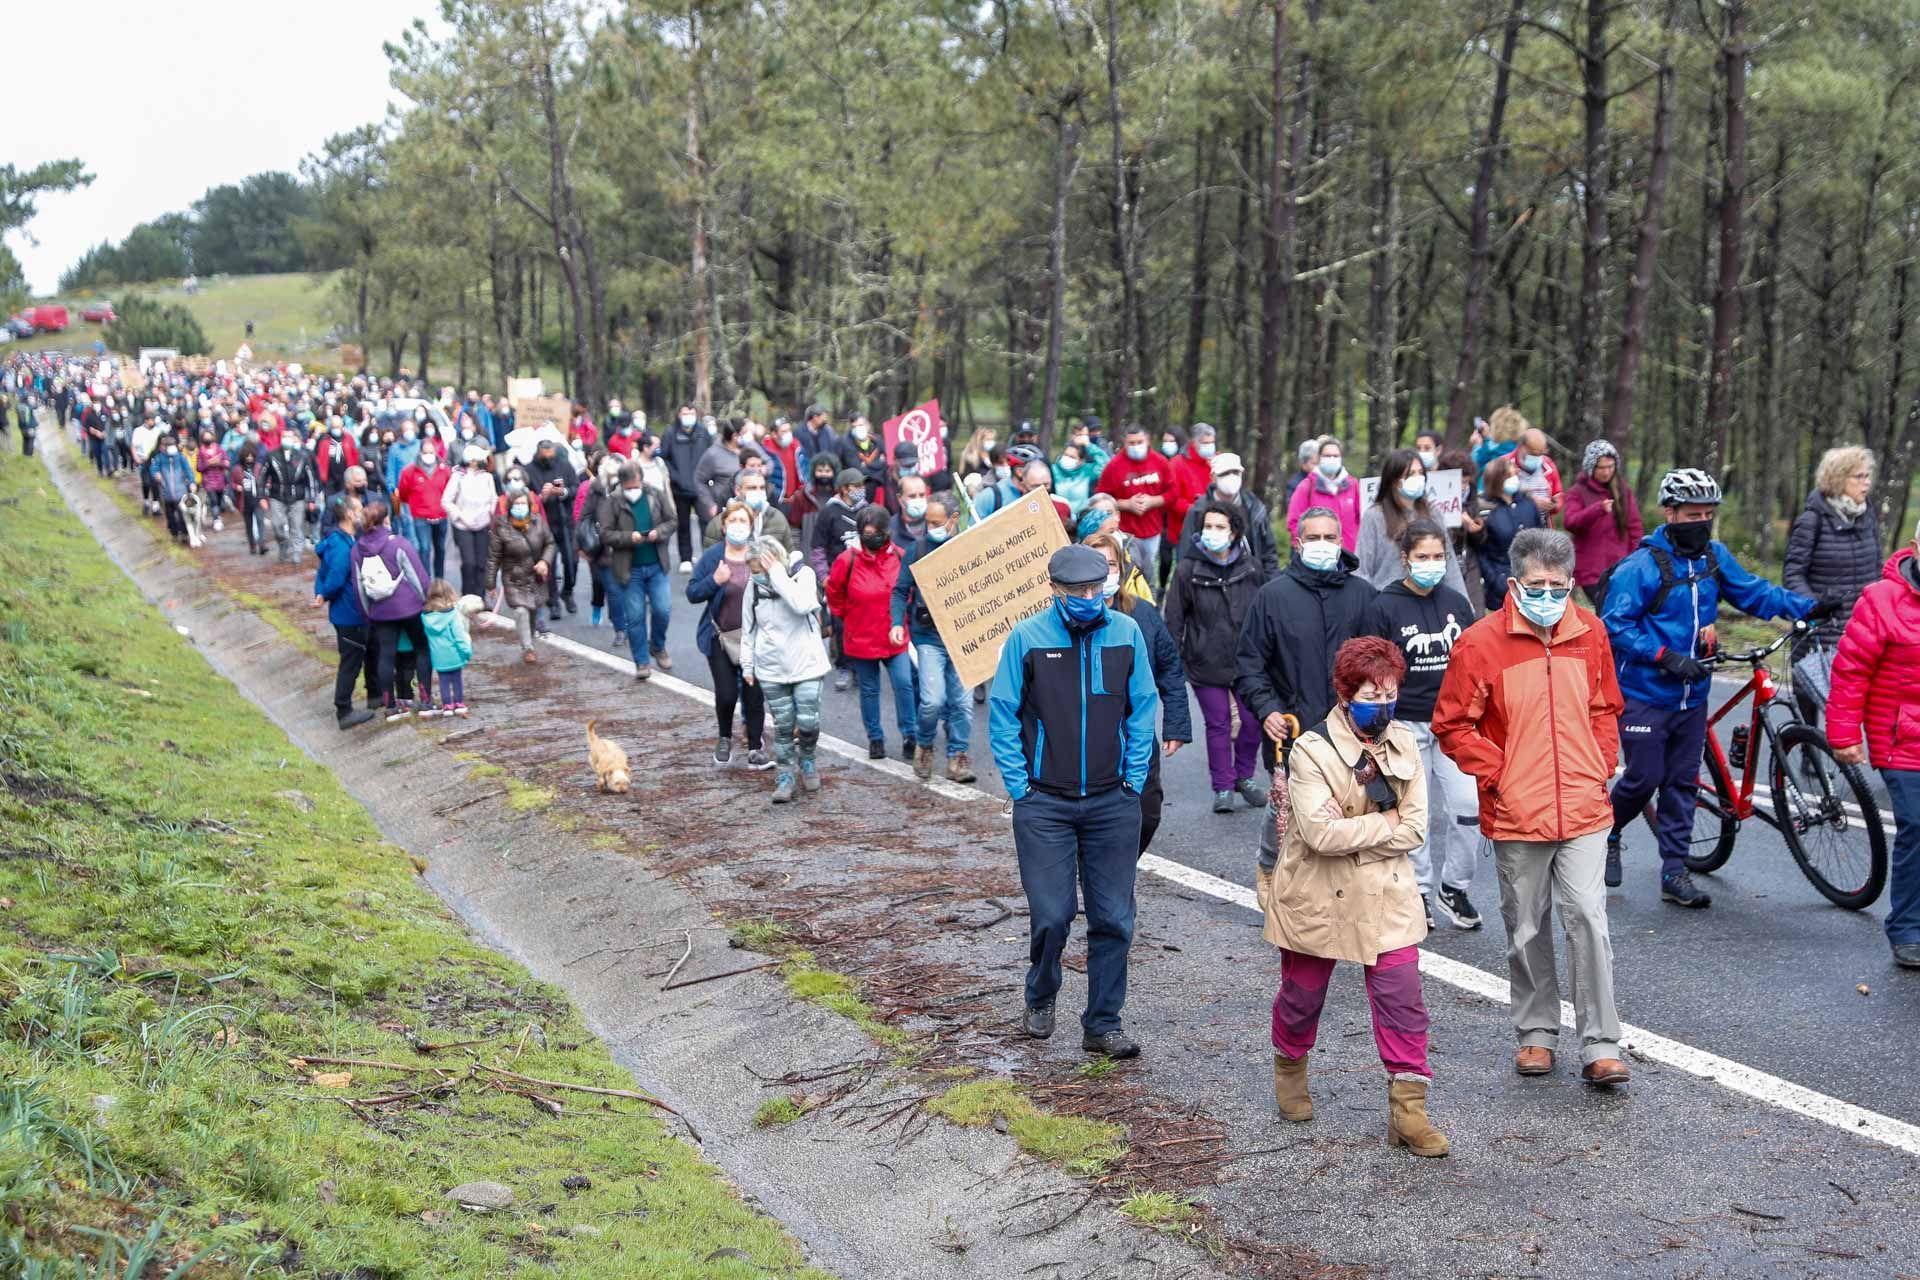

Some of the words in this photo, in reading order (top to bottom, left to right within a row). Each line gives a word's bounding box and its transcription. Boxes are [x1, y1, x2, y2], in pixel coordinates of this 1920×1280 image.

[1006, 524, 1038, 551] MONTES
[968, 568, 1005, 597] REGATOS
[1400, 624, 1419, 637] SOS
